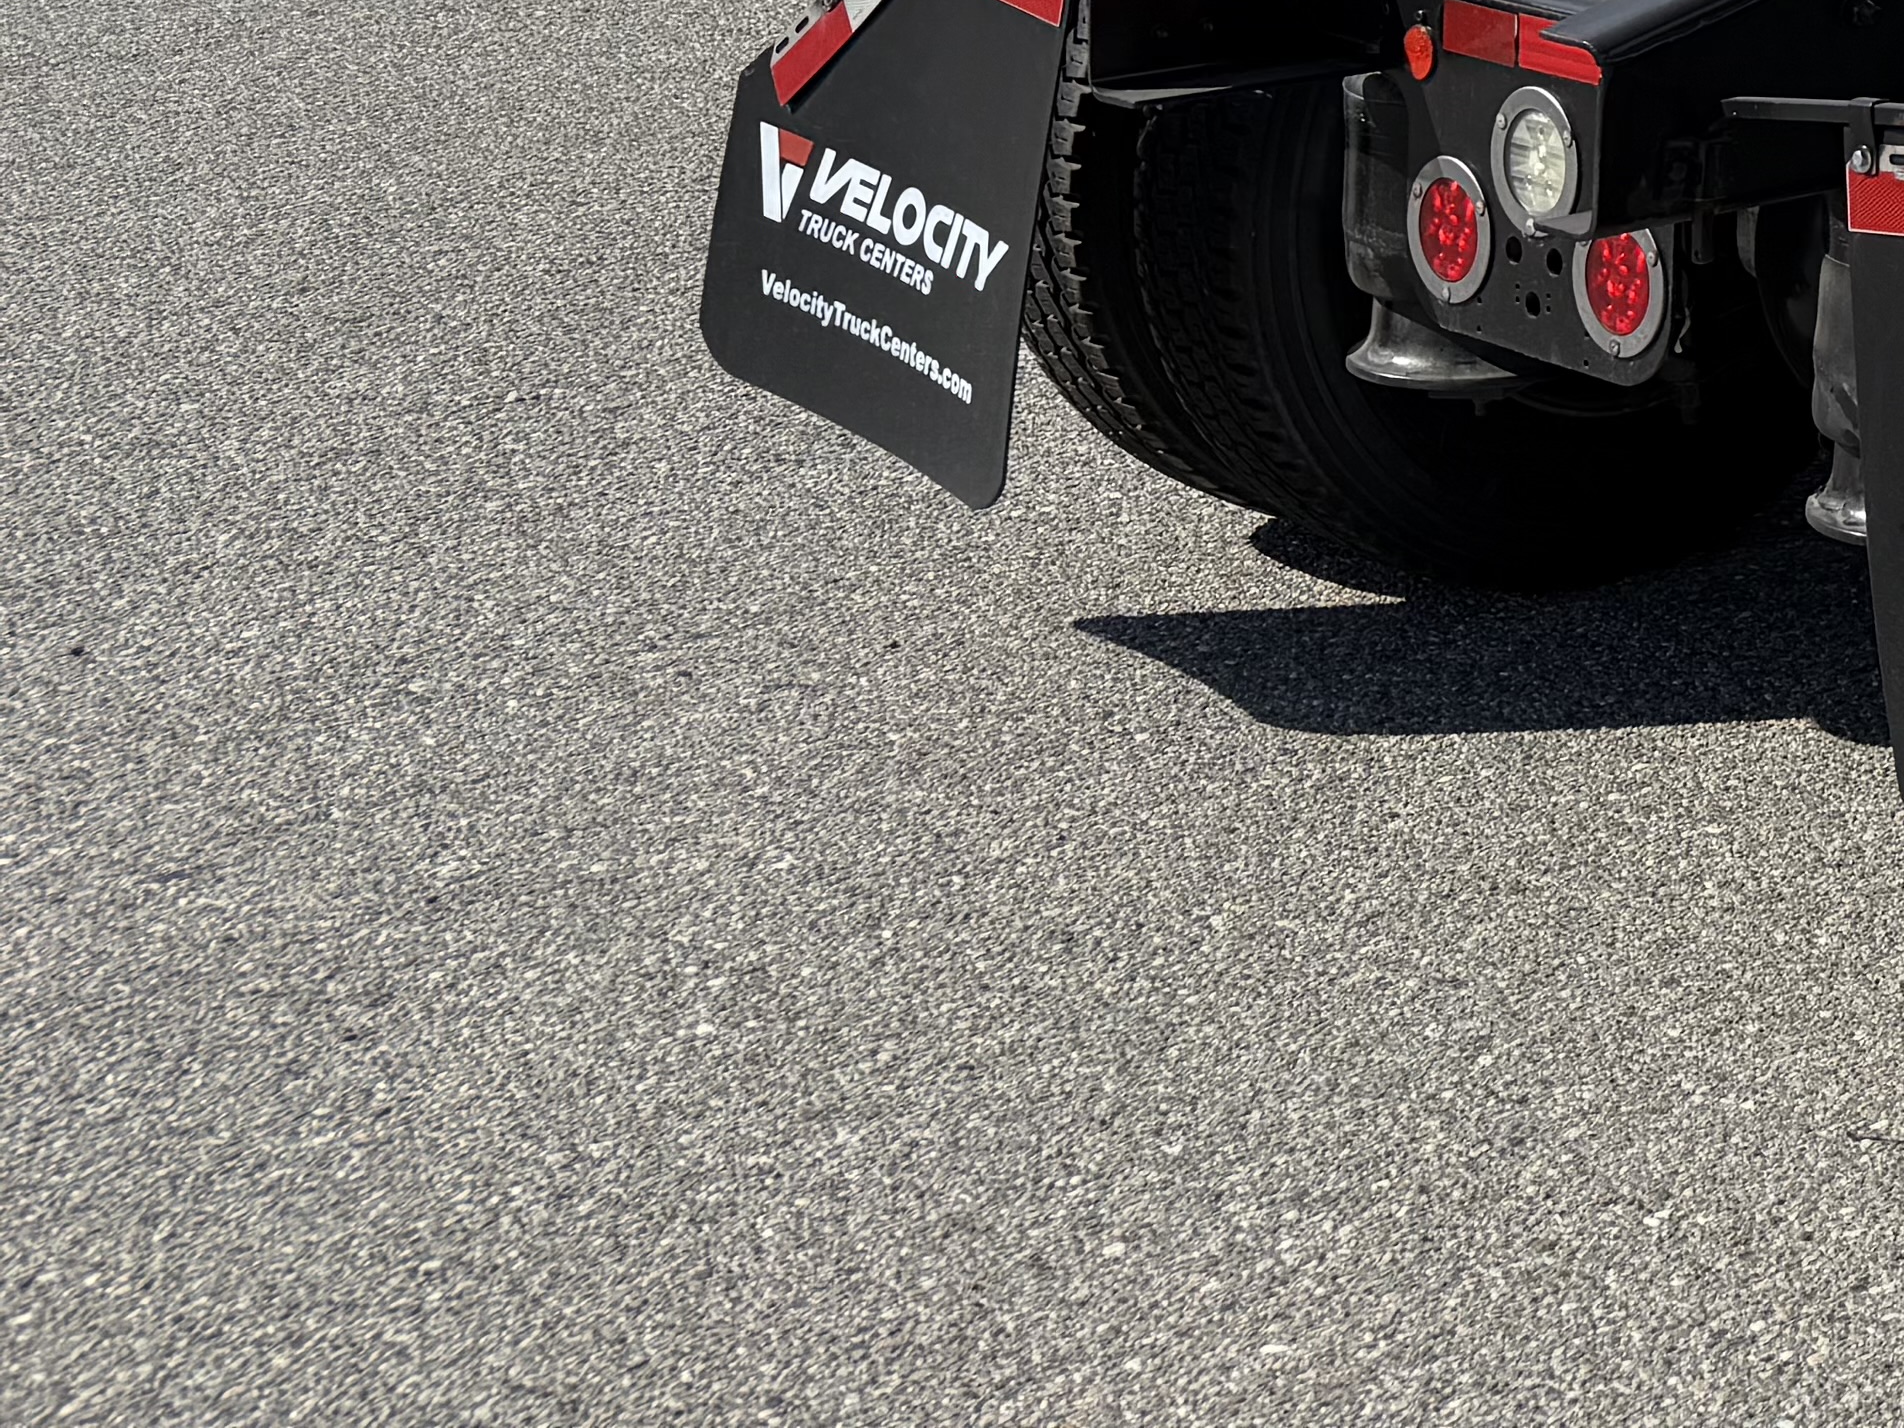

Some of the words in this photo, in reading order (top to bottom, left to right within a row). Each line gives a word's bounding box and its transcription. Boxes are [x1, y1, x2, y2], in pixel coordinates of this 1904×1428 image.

[798, 209, 859, 256] TRUCK
[859, 237, 934, 296] CENTERS
[808, 147, 1010, 292] VELOCITY
[761, 269, 973, 405] VelocityTruckCenters.com
